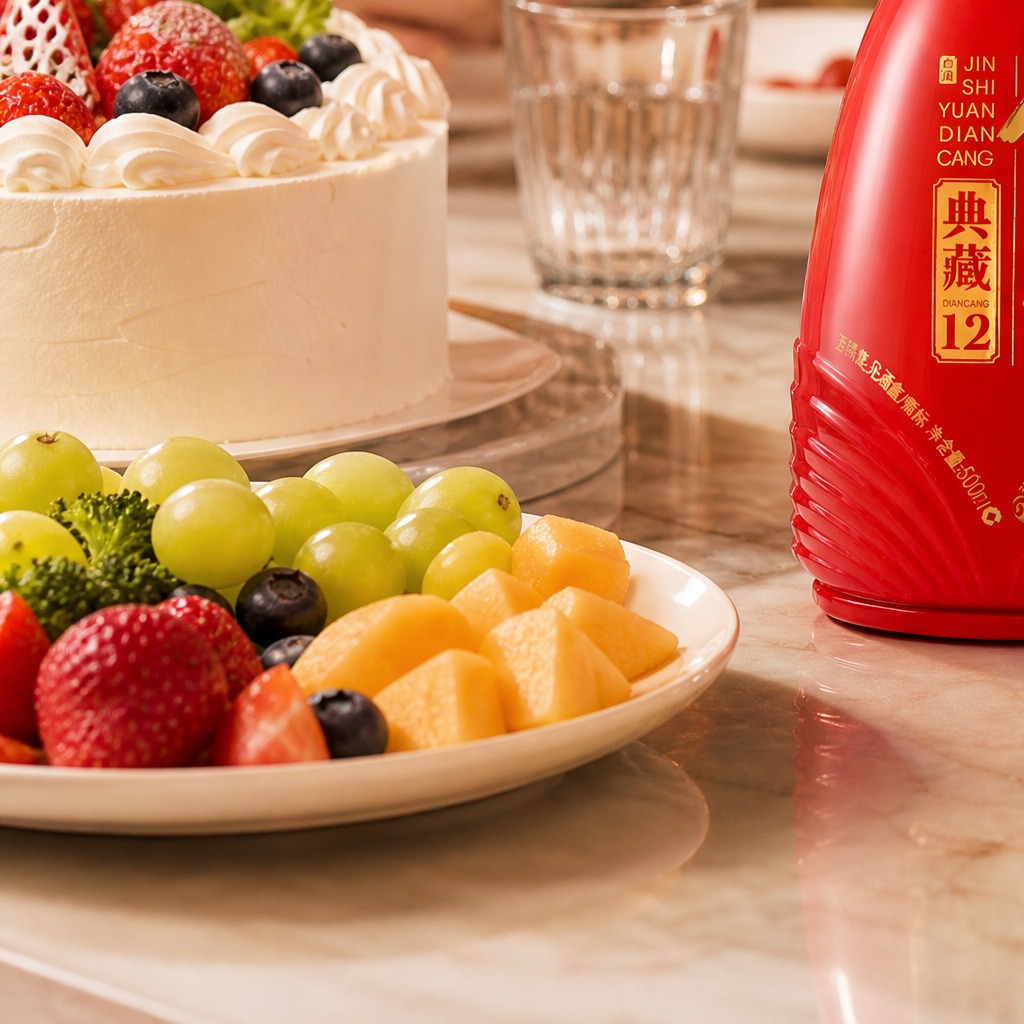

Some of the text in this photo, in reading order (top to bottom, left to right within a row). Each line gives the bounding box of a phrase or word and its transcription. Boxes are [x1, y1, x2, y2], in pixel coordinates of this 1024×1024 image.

[963, 56, 996, 72] JIN
[962, 79, 995, 95] SHI
[938, 102, 995, 119] YUAN
[939, 125, 995, 143] DIAN
[936, 149, 994, 167] CANG
[942, 190, 992, 292] 典藏
[942, 299, 990, 308] DIANCANG
[941, 313, 991, 351] 12
